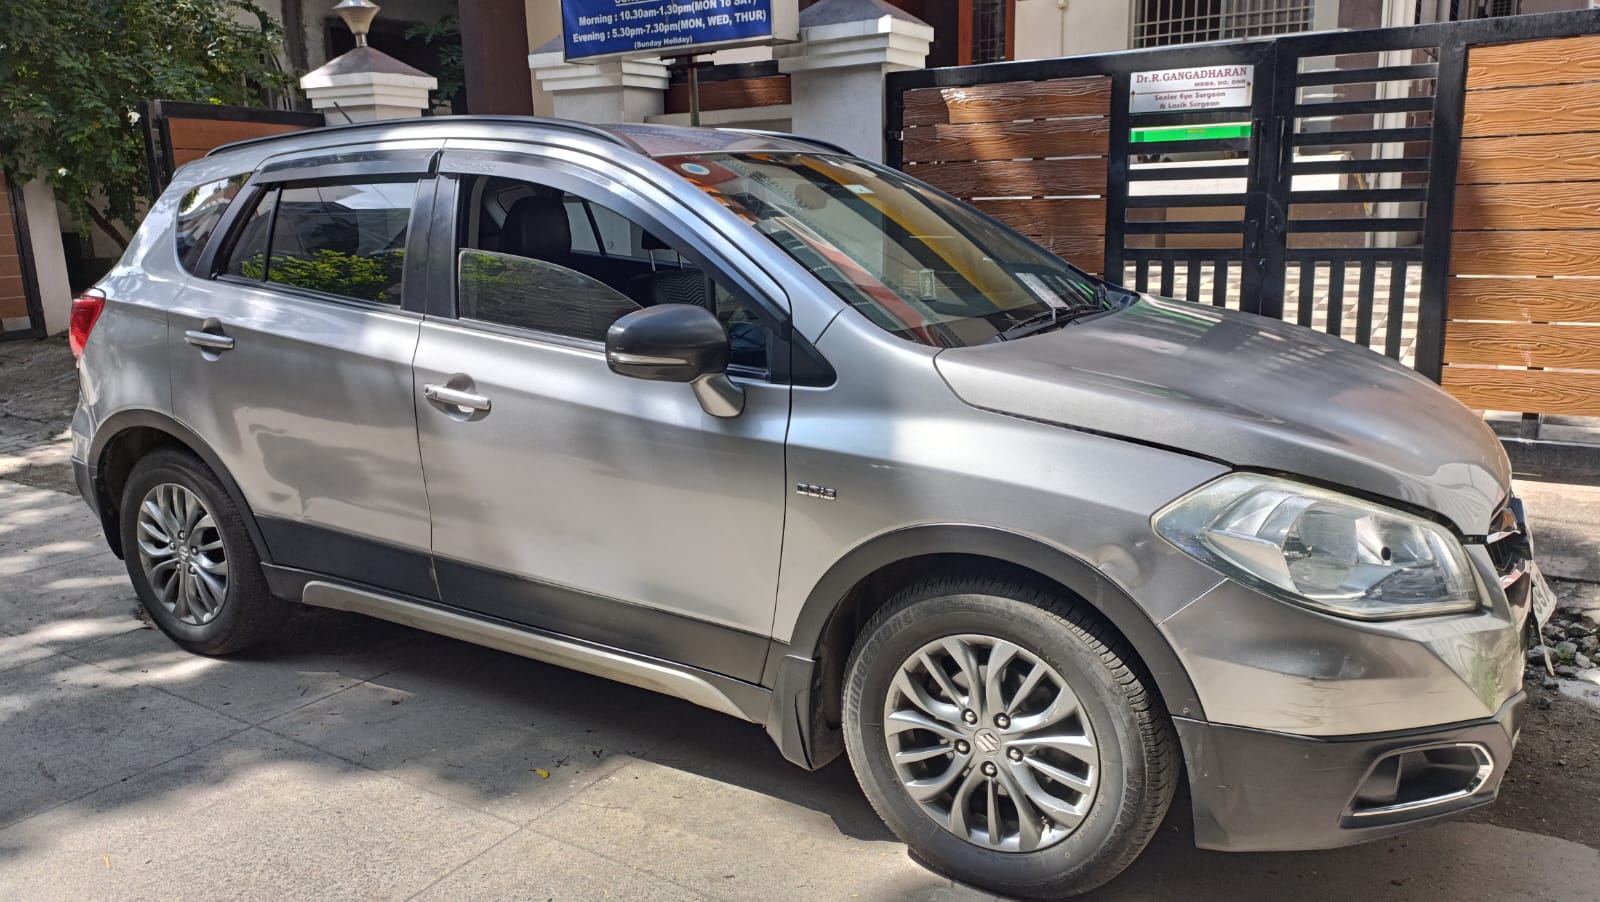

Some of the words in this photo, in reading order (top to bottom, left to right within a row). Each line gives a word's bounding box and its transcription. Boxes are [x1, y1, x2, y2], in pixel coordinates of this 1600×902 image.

[573, 32, 605, 43] Evening
[708, 14, 732, 26] WED,
[734, 9, 766, 23] THUR)
[579, 14, 612, 26] Morning
[634, 39, 661, 49] (Sunday
[663, 35, 693, 45] Holiday)
[1136, 67, 1247, 83] Dr.R.GANGADHARAN
[1195, 91, 1226, 99] Surgeon
[1168, 101, 1187, 109] Lasik
[1189, 101, 1220, 109] Surgeon
